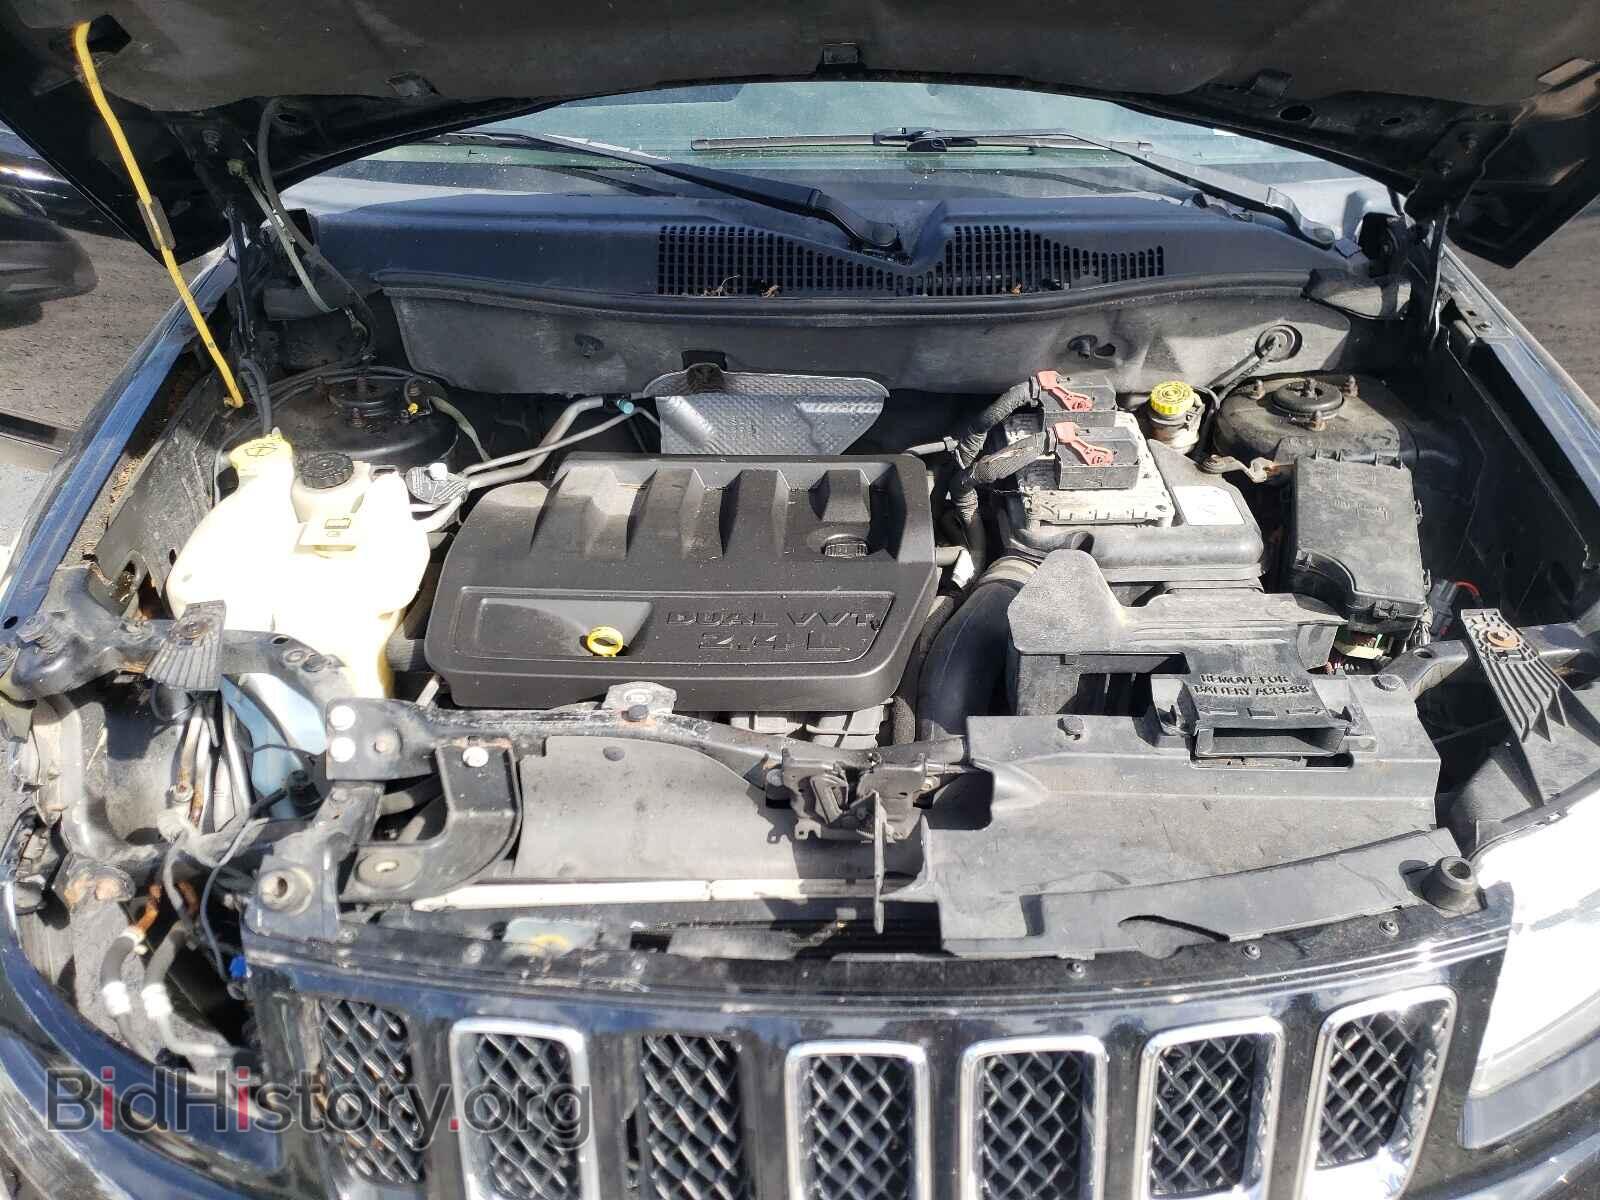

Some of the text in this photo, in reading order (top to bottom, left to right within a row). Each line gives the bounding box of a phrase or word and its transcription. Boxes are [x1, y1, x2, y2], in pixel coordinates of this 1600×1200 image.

[666, 611, 875, 628] DUAL VVT
[1201, 674, 1289, 684] REMOVE FOR
[1194, 685, 1309, 696] BATTERY ACCESS
